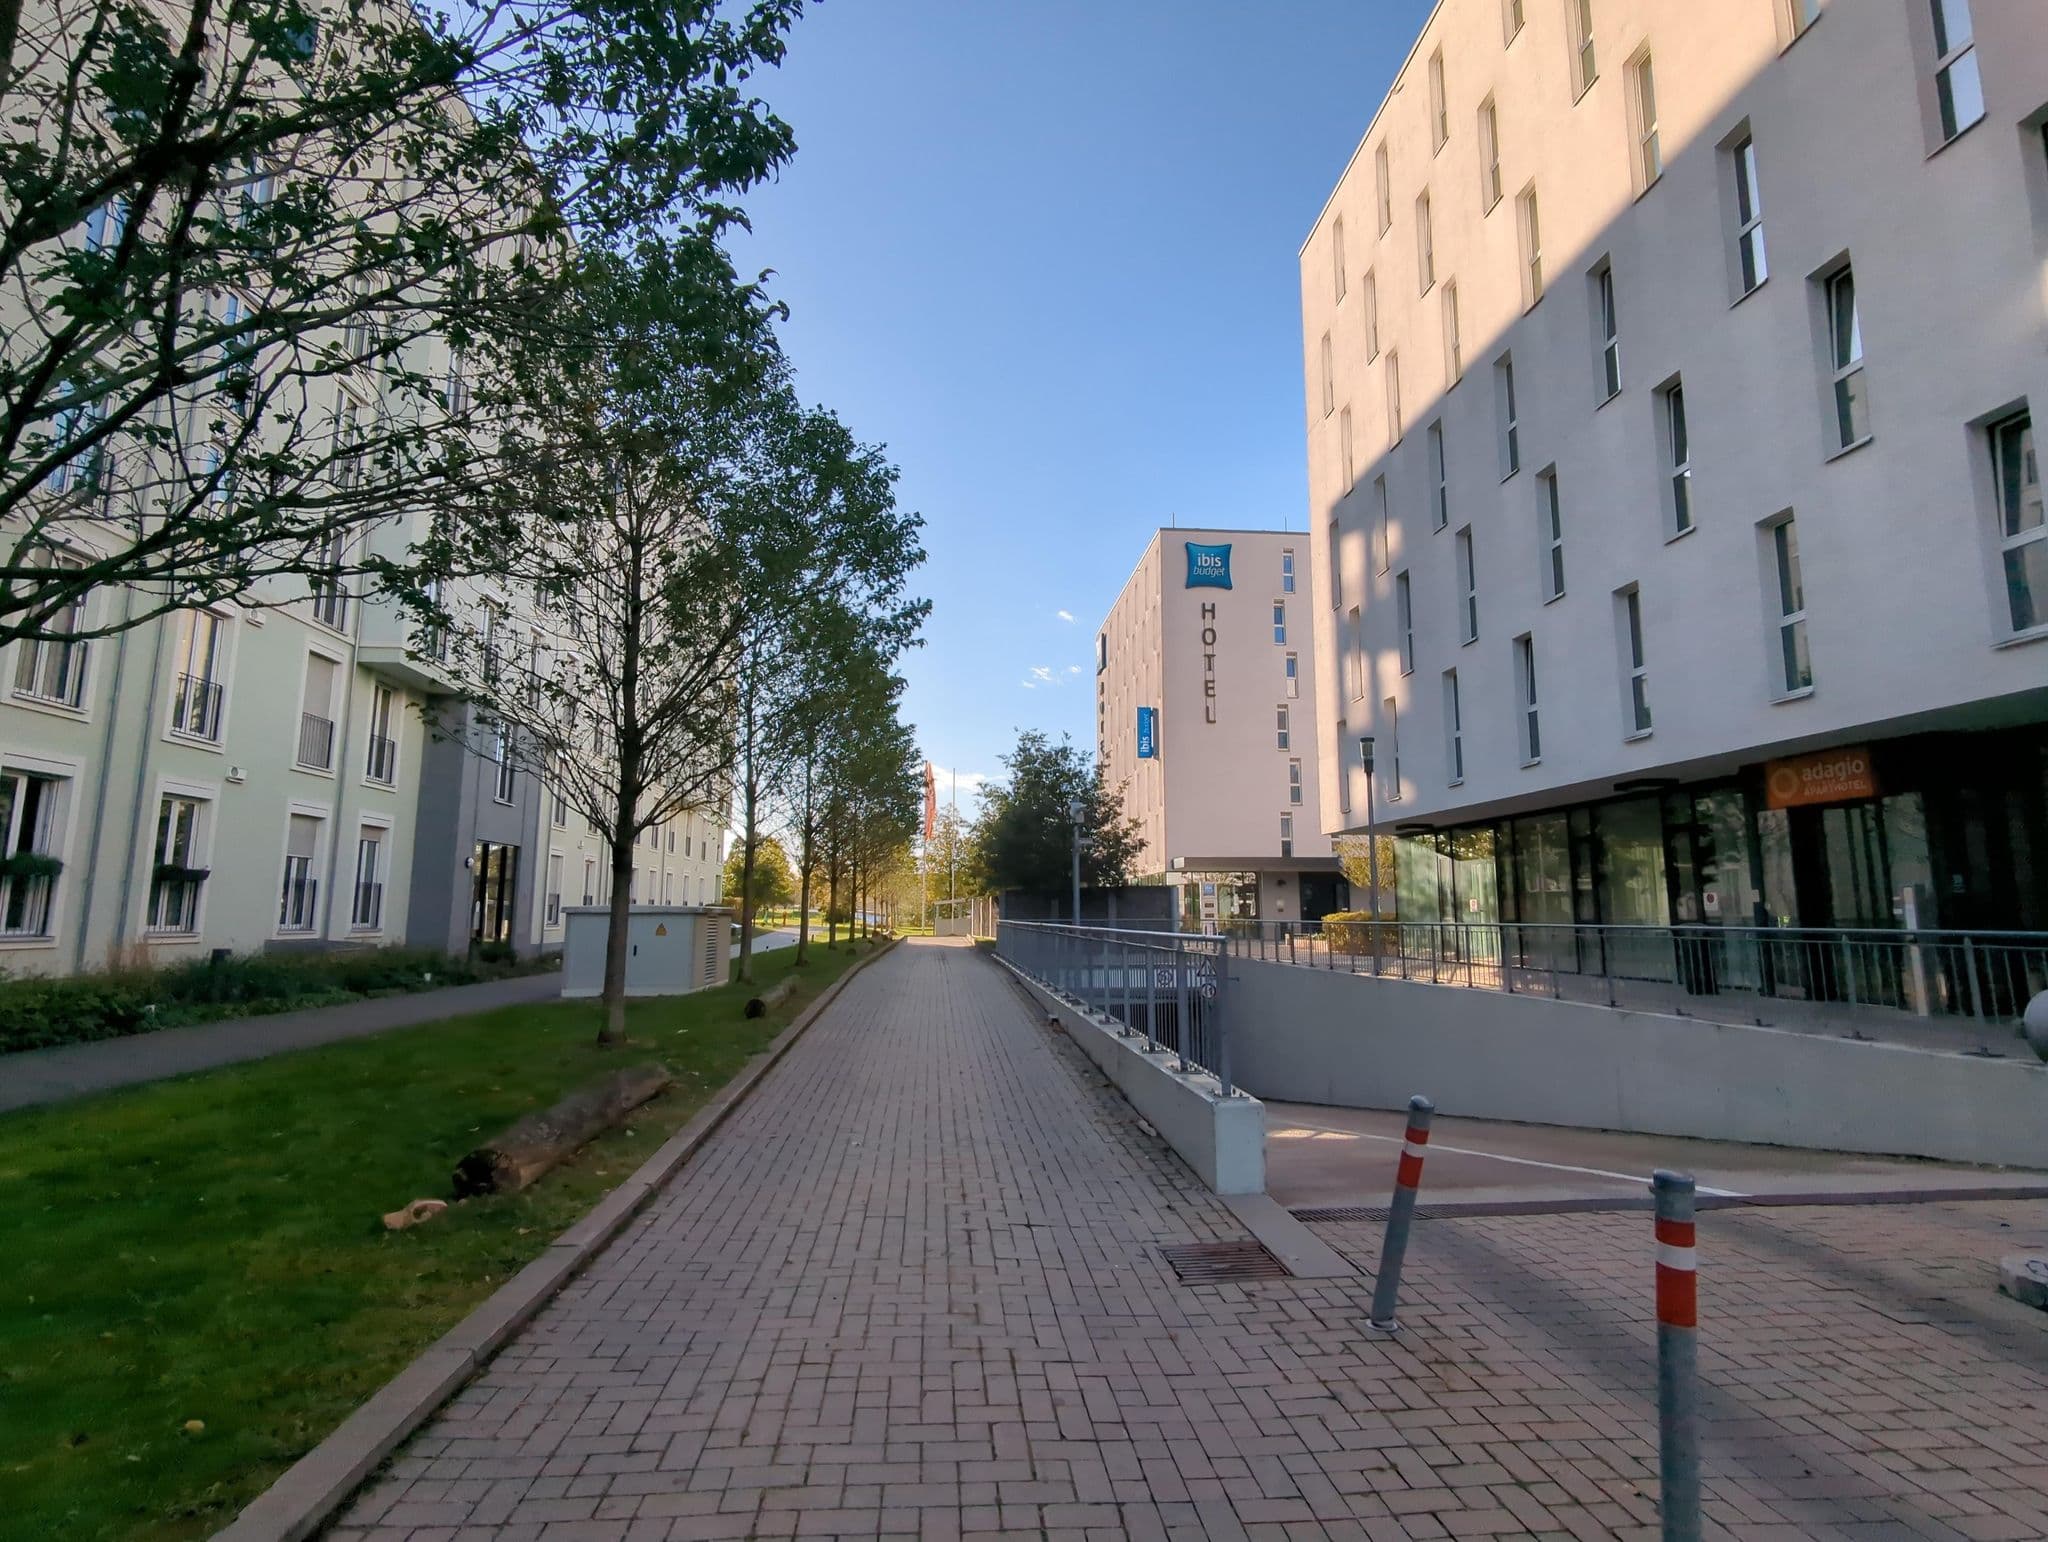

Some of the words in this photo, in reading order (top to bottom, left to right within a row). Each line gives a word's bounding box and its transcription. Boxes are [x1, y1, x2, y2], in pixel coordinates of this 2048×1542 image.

[1197, 553, 1222, 567] ibis
[1193, 566, 1225, 578] budget
[1201, 602, 1217, 724] HOTEL
[1140, 736, 1150, 753] ibis
[1802, 755, 1865, 782] adagio
